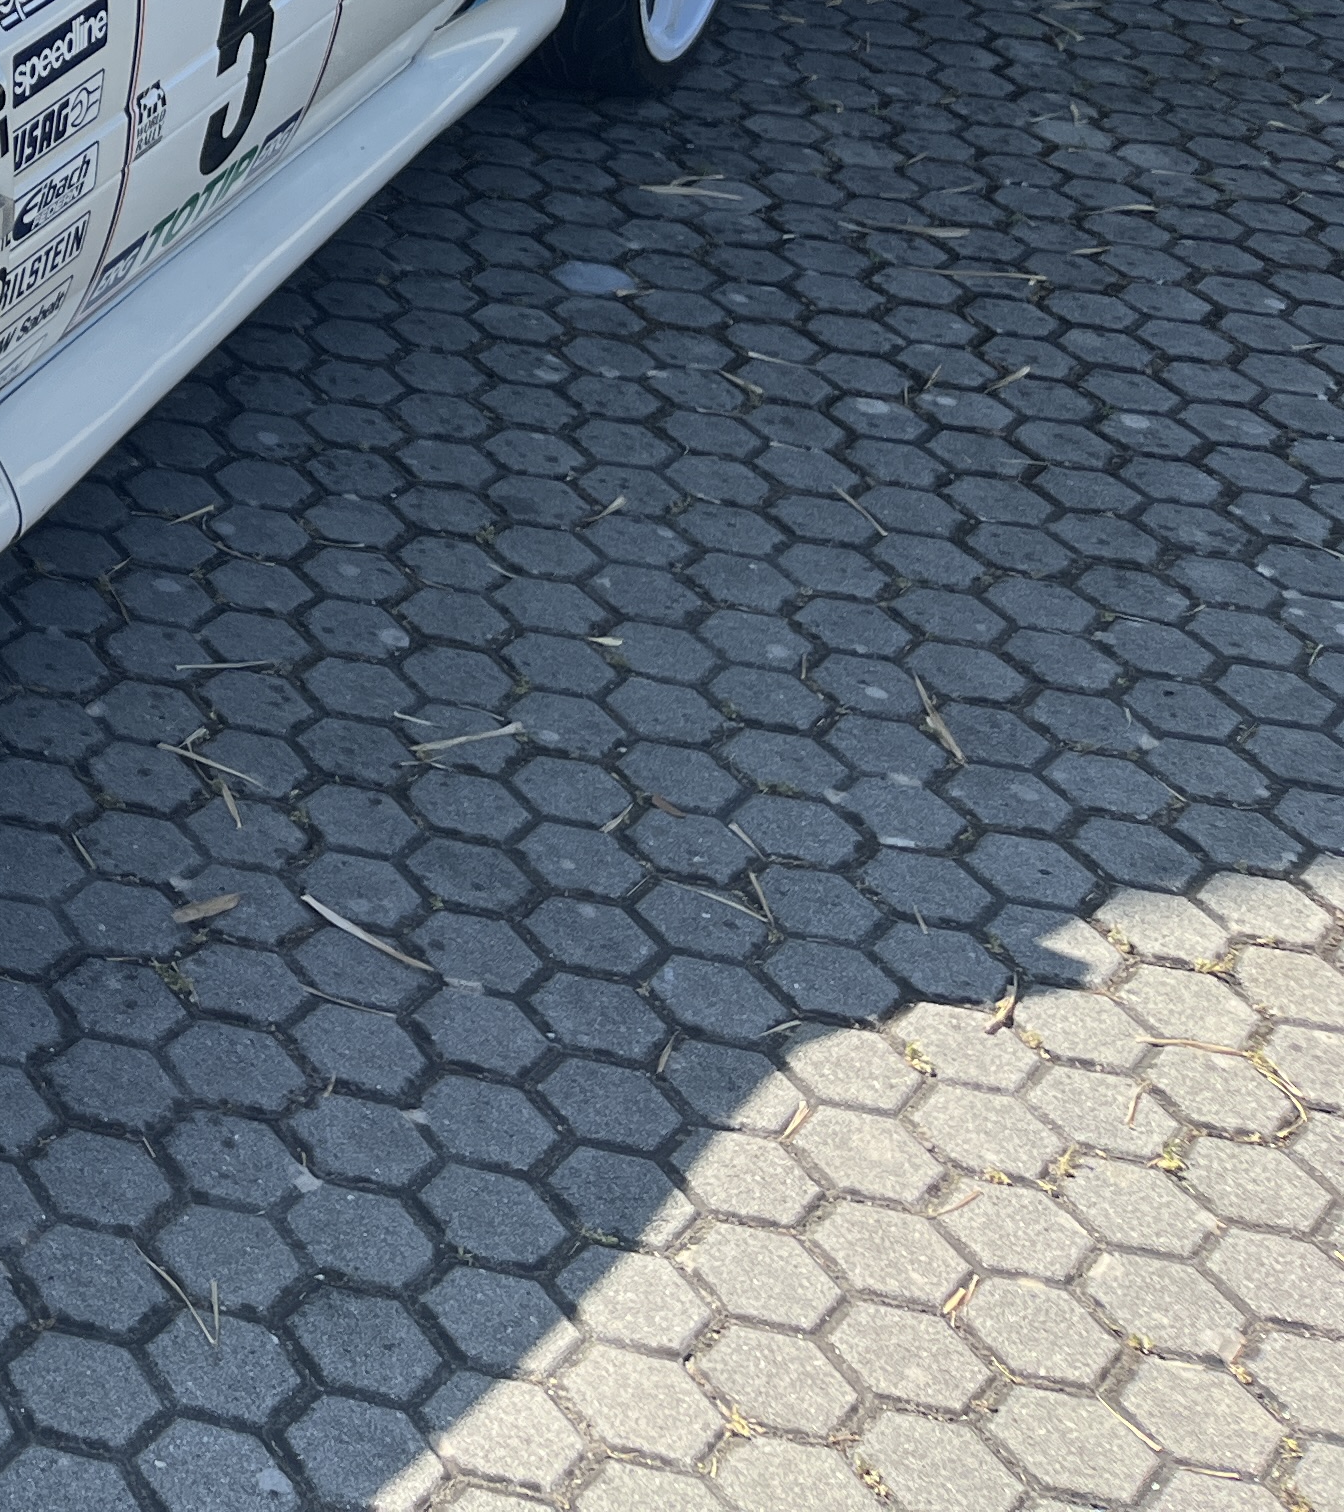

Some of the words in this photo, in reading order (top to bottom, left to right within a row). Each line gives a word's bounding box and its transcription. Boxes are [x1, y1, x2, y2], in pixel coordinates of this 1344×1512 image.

[14, 9, 108, 96] speedline
[13, 97, 70, 172] USAG
[14, 153, 90, 241] Eibach
